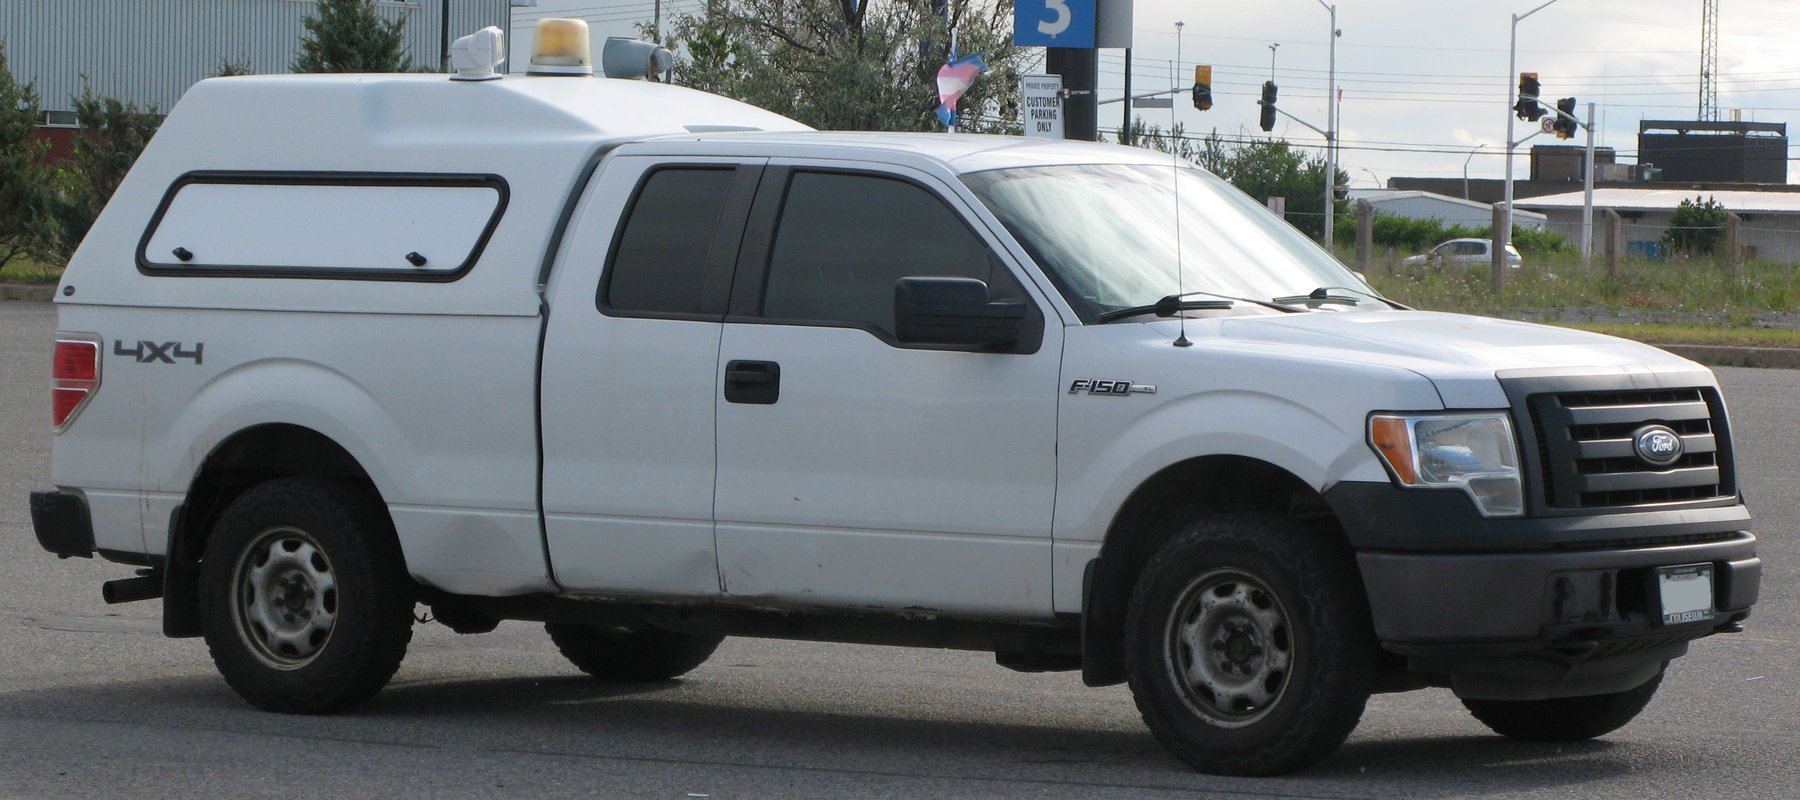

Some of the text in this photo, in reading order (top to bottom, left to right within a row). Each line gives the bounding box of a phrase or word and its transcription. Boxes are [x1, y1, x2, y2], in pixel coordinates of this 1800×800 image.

[1026, 96, 1060, 107] CUSTOMER
[1030, 109, 1057, 120] PARKING
[1036, 121, 1052, 132] ONLY
[1652, 434, 1674, 452] Ford
